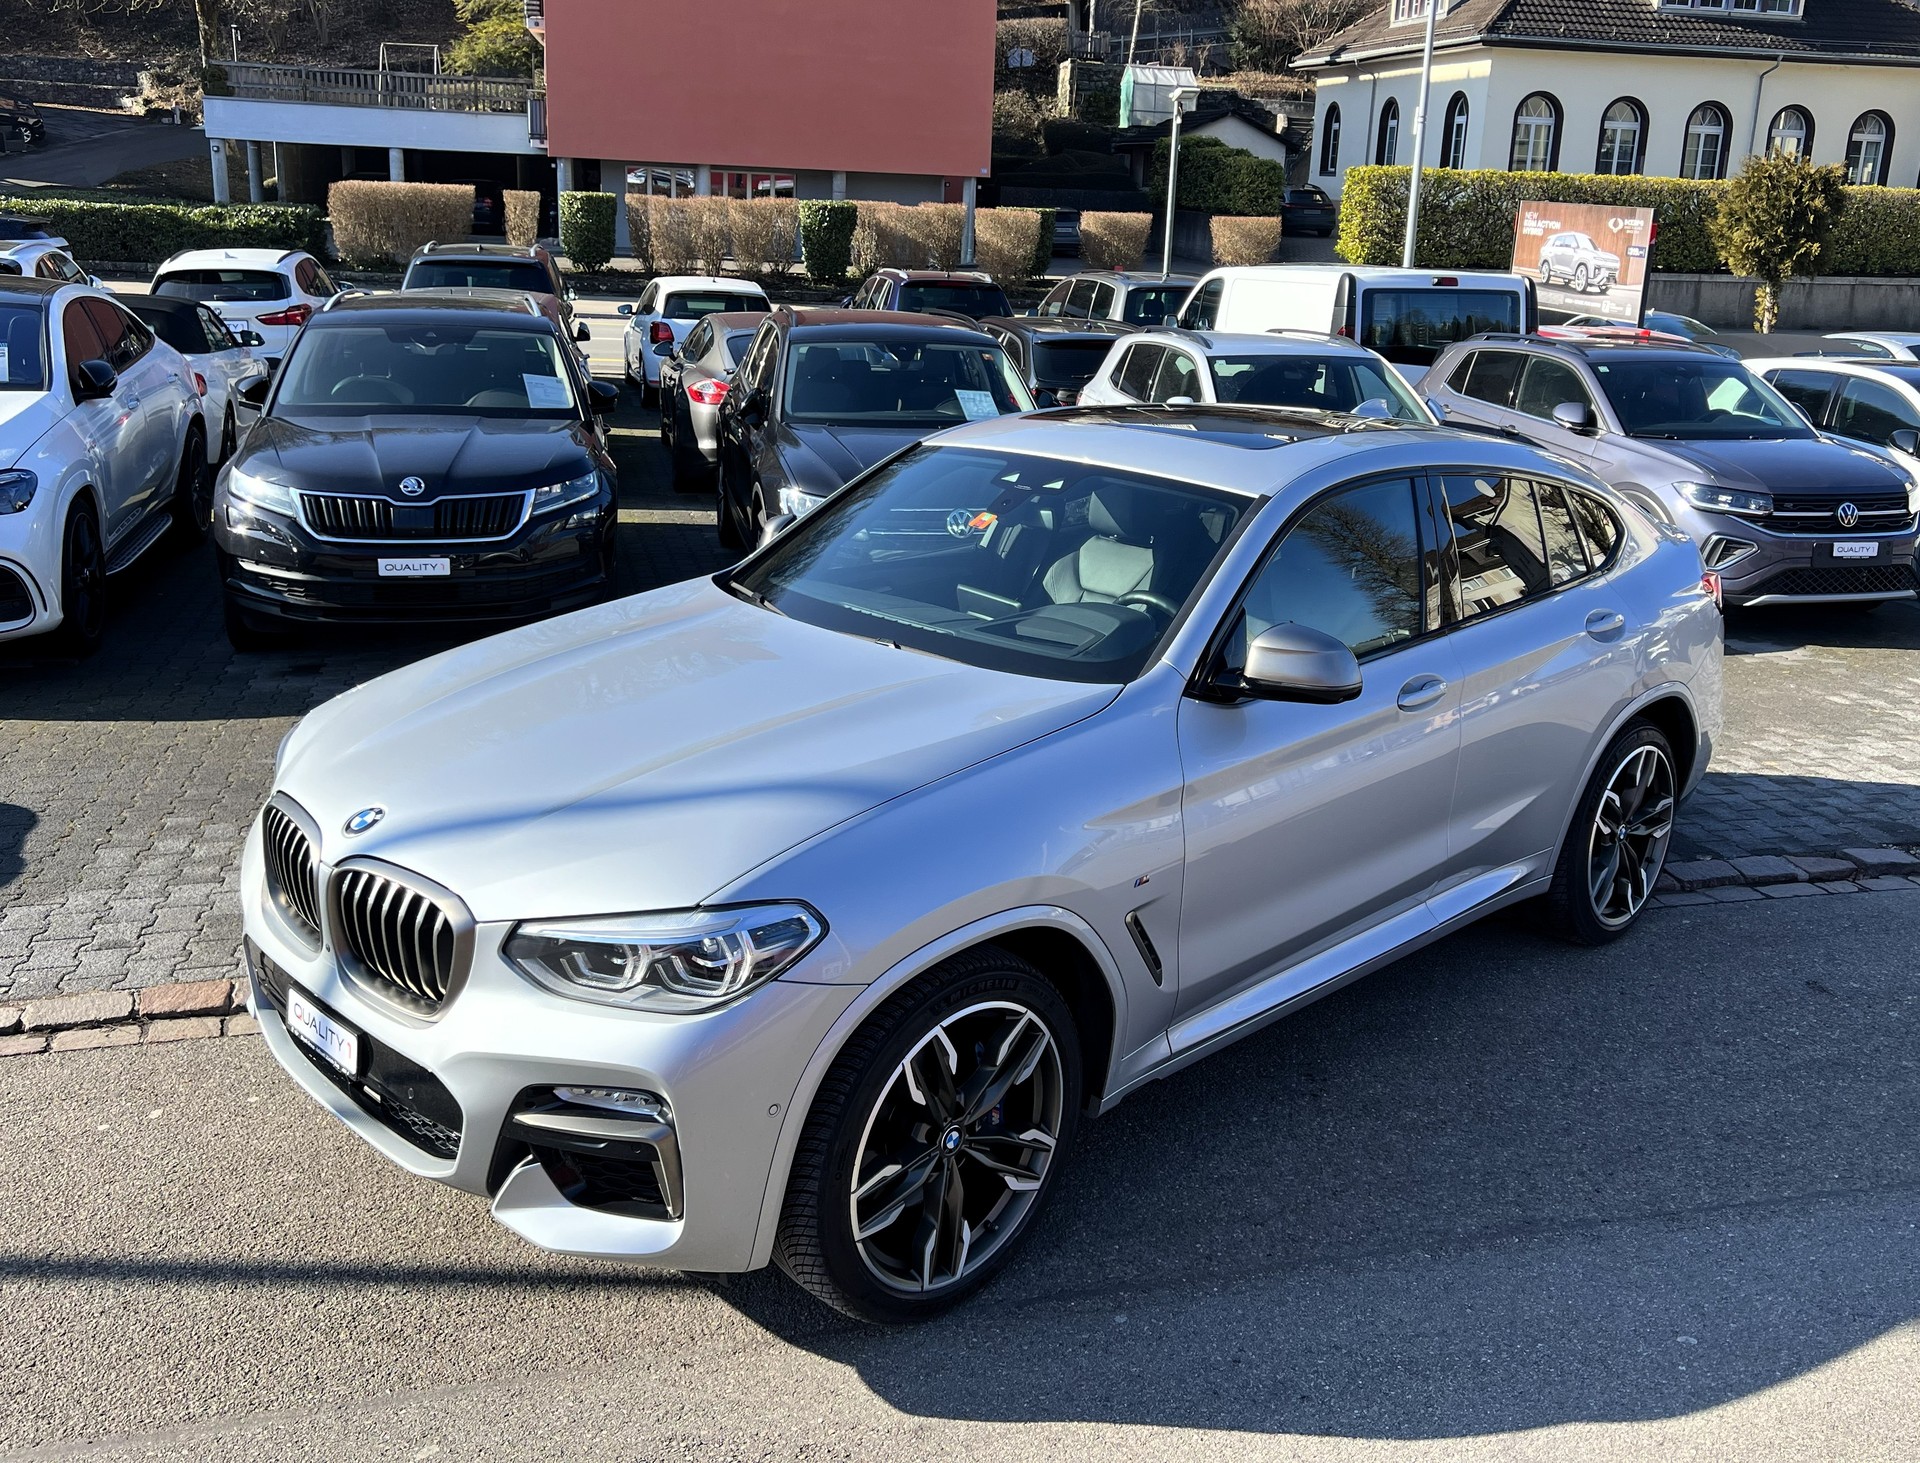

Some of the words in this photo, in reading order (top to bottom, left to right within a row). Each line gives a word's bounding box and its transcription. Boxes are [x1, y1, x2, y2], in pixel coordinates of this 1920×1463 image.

[385, 563, 438, 571] QUALITY
[950, 979, 1016, 1003] MICHELIN
[294, 1003, 345, 1051] QUALITY
